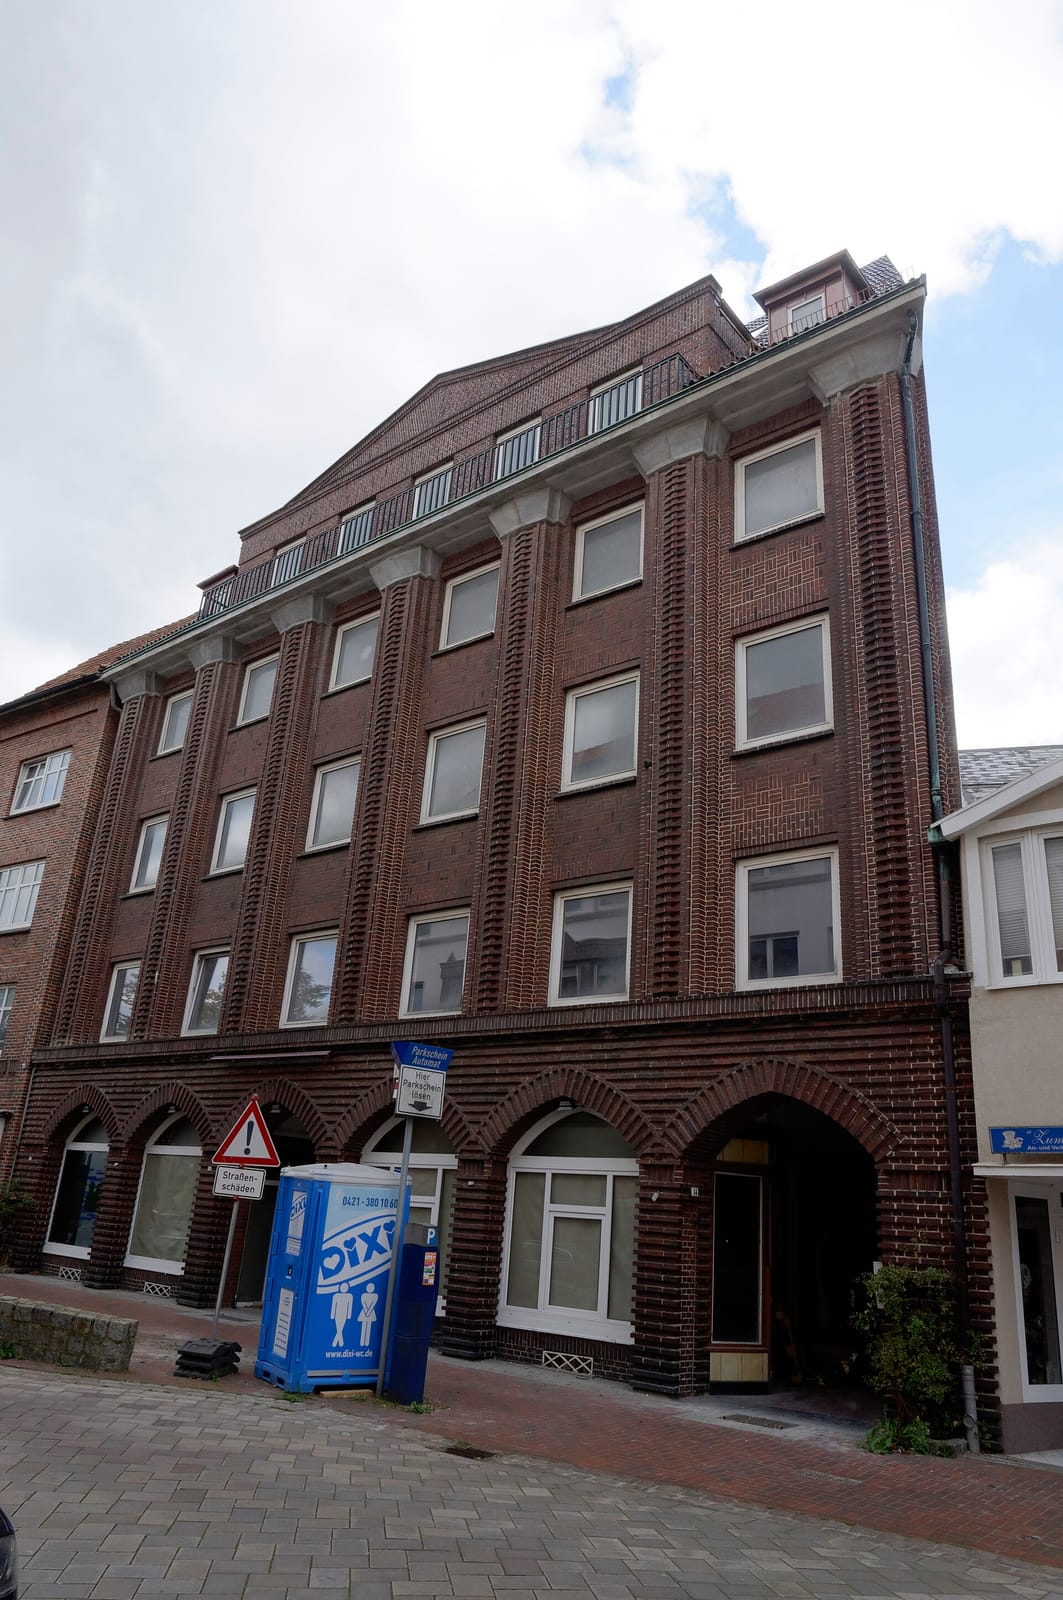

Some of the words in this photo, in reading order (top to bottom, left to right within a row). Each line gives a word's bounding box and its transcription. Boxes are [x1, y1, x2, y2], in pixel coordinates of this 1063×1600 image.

[411, 1045, 448, 1061] Parkschein
[412, 1056, 441, 1068] Automat
[415, 1072, 430, 1081] Hier
[403, 1079, 441, 1092] Parkschein
[411, 1090, 431, 1100] lösen
[222, 1171, 258, 1183] Straßen-
[221, 1182, 255, 1193] schäden
[342, 1196, 360, 1206] 0421
[365, 1197, 379, 1208] 380
[380, 1198, 389, 1208] 10
[426, 1228, 435, 1245] P
[325, 1349, 373, 1359] www.dixi-wc.de
